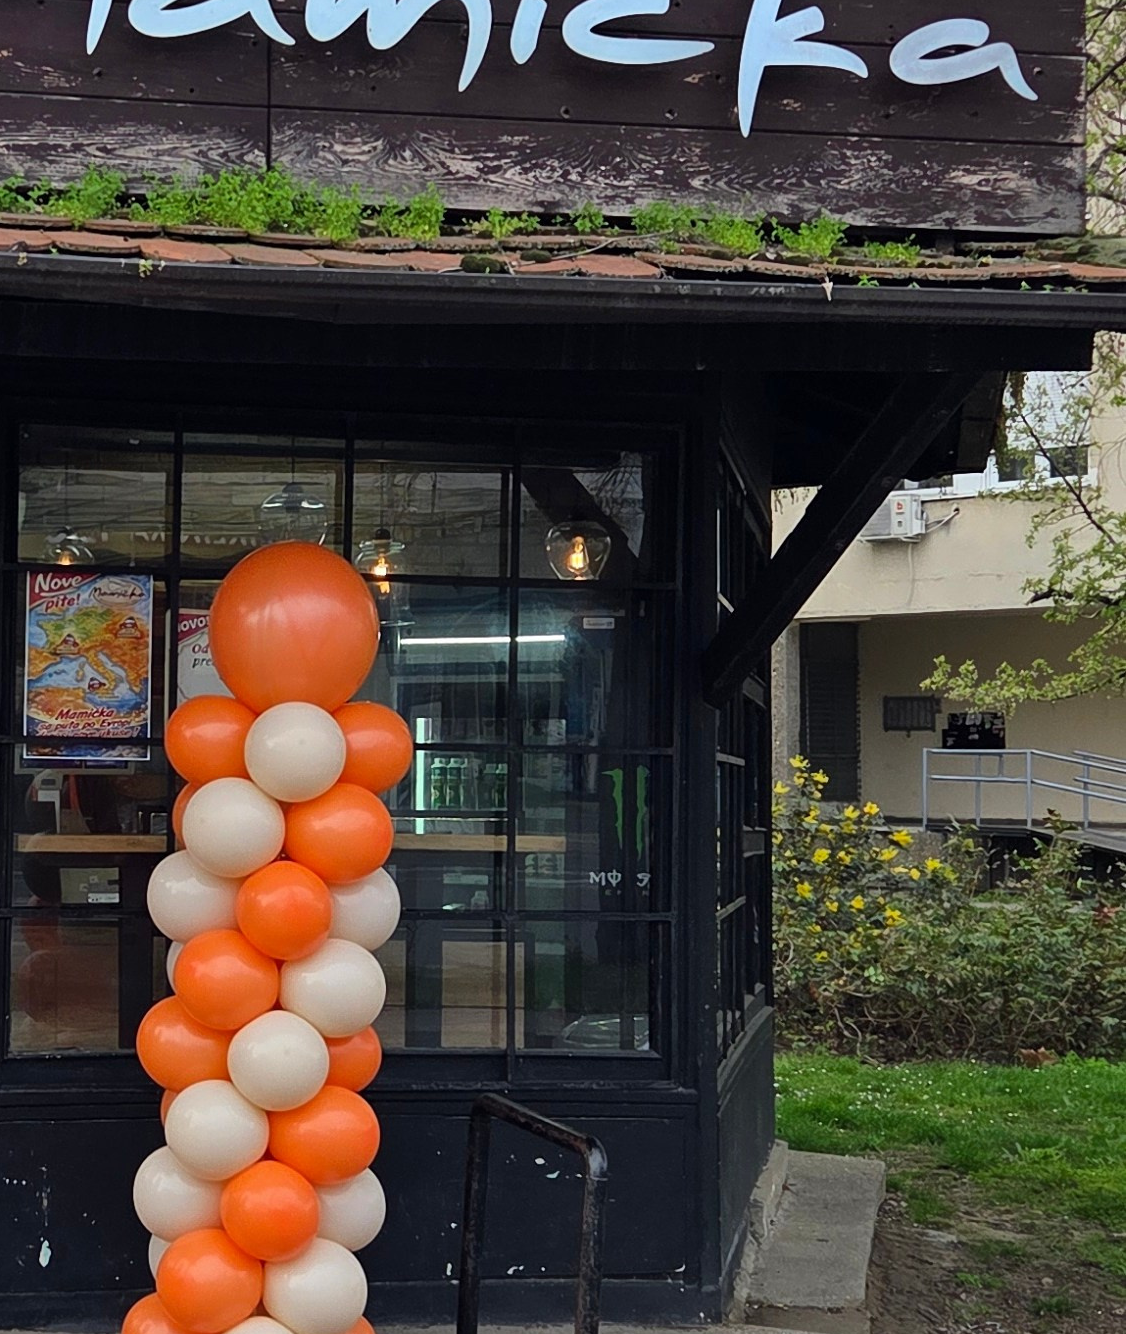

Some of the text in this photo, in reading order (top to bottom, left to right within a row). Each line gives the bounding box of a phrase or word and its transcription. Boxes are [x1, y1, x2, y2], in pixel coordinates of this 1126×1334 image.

[33, 572, 82, 593] Nove
[44, 593, 81, 612] pite!
[55, 706, 115, 721] Mamička
